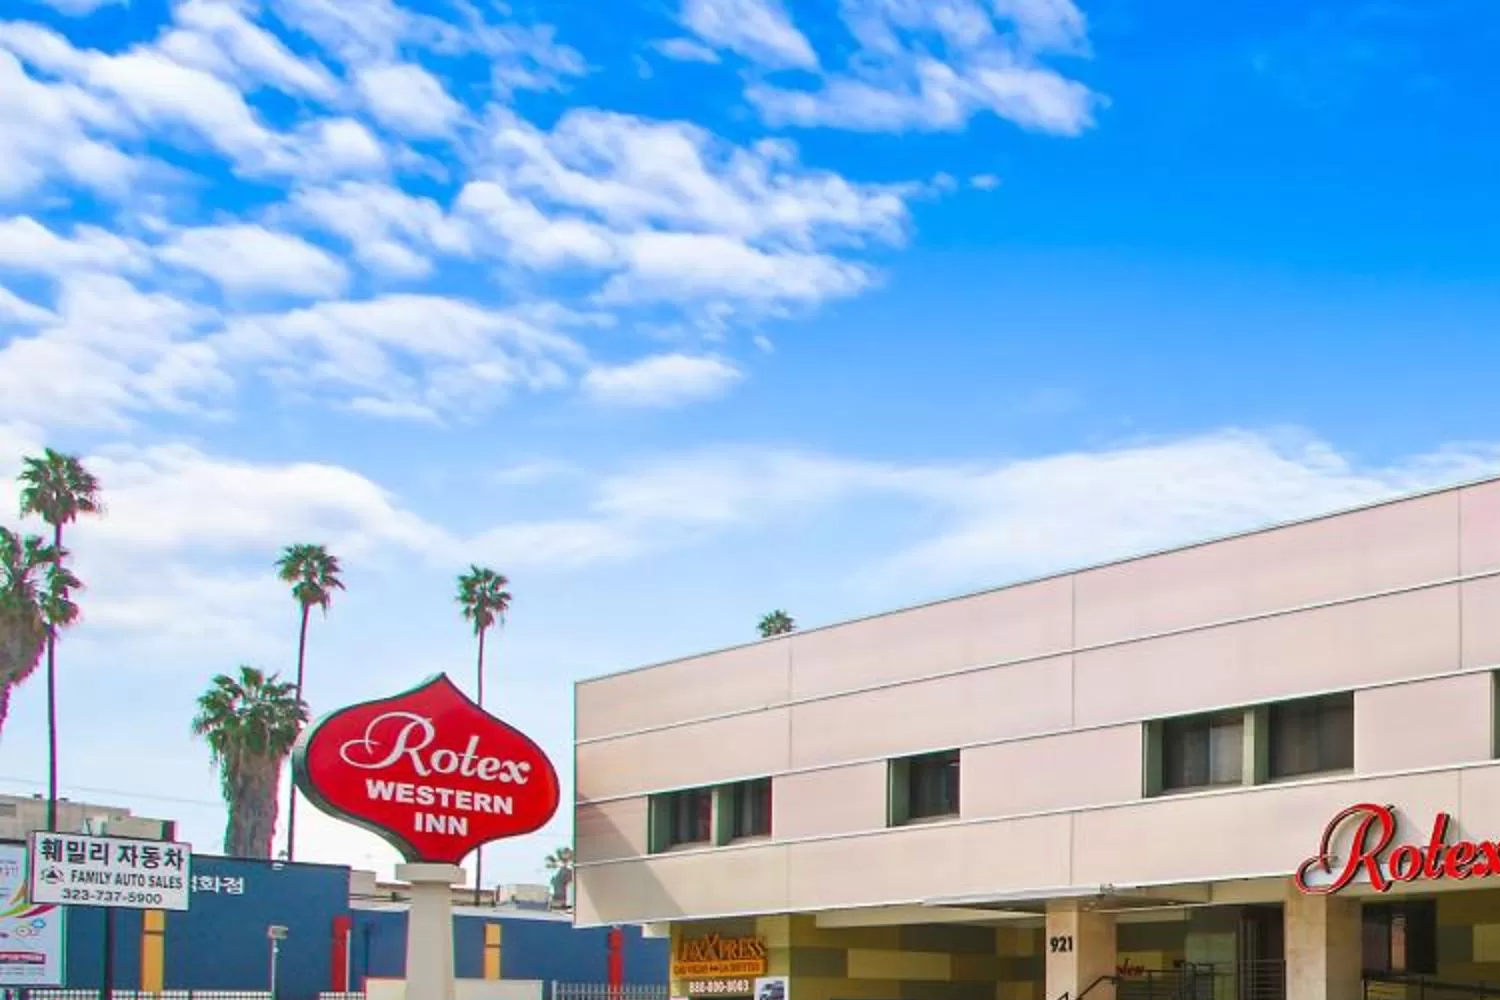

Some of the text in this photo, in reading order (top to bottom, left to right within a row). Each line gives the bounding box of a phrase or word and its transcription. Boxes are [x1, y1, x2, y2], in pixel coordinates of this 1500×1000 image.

[340, 711, 532, 785] Rotex
[365, 778, 514, 815] WESTERN
[414, 811, 469, 836] INN
[117, 844, 185, 872] 자동차
[70, 868, 184, 889] FAMILY AUTO SALES
[62, 887, 163, 905] 323-737-5900
[1050, 936, 1073, 953] 921
